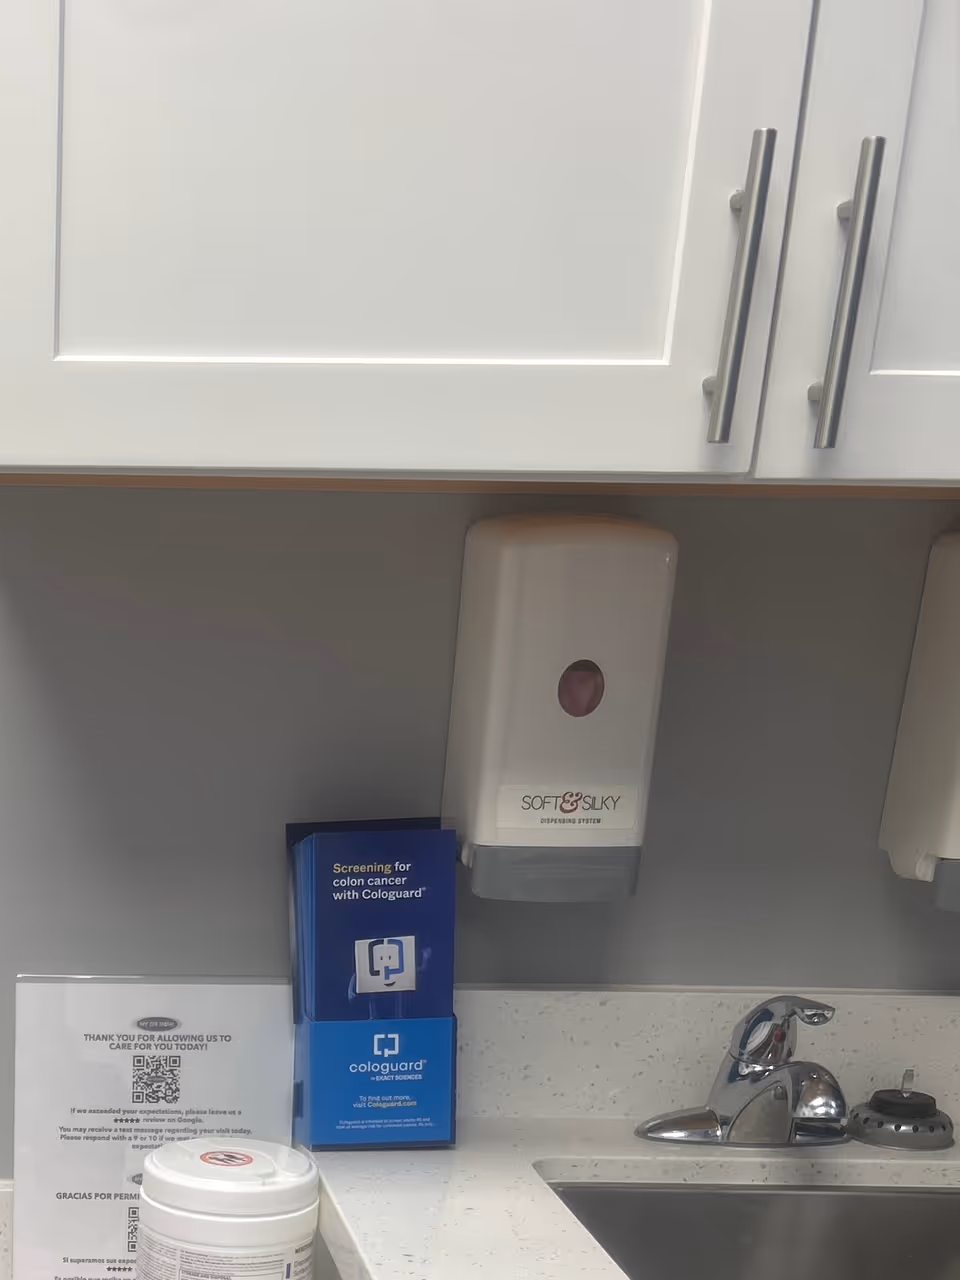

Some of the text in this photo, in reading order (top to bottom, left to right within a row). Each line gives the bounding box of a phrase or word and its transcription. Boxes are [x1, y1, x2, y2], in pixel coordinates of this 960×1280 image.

[521, 795, 561, 811] SOFT
[581, 795, 621, 811] SILKY
[332, 861, 412, 875] Screening for
[332, 876, 407, 887] colon cancer
[332, 889, 359, 901] with
[84, 1033, 232, 1043] THANK YOU FOR ALLOWING US TO
[109, 1042, 132, 1050] CARE
[134, 1042, 152, 1050] FOR
[175, 1043, 208, 1051] TODAY!
[56, 1192, 93, 1200] GRACIAS
[94, 1192, 112, 1200] POR
